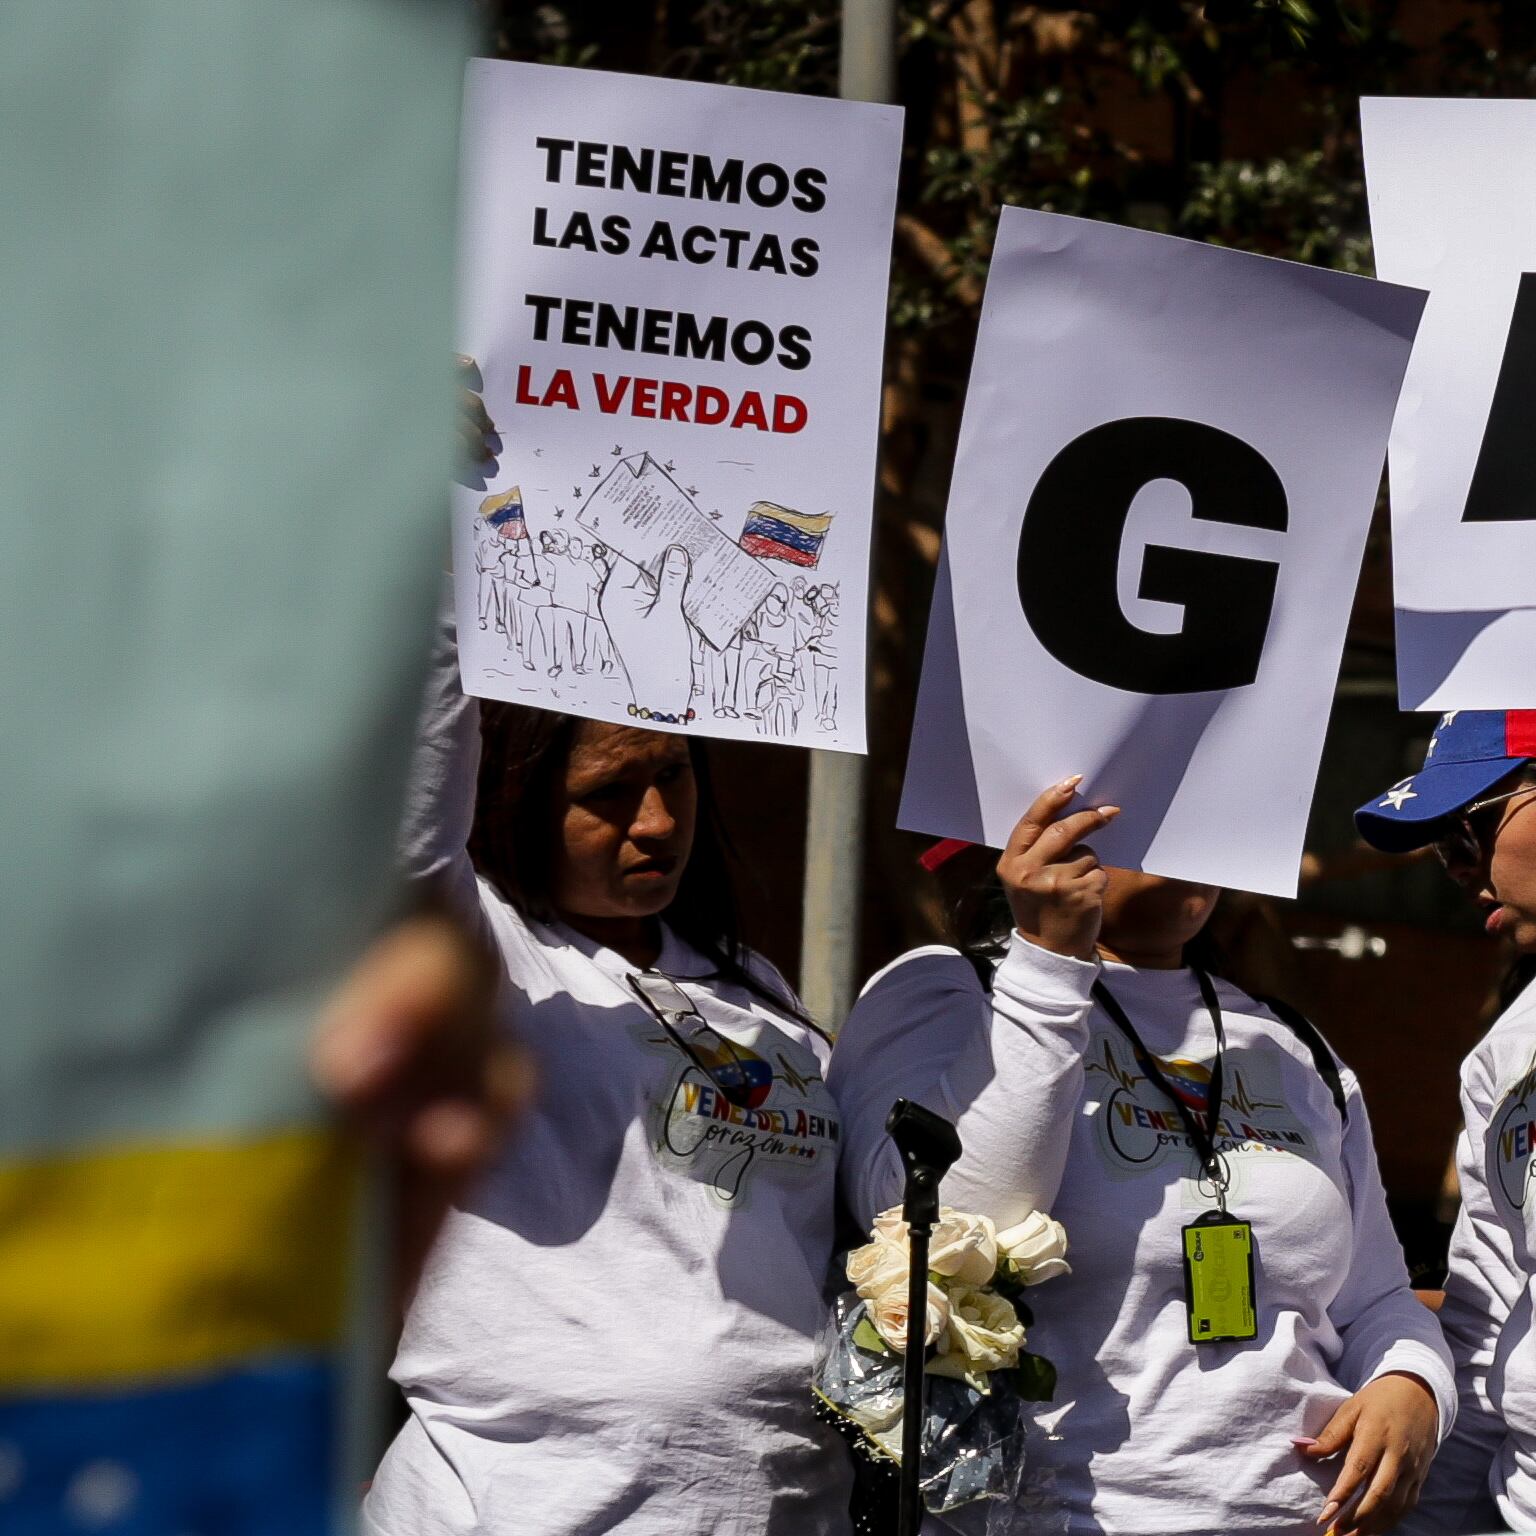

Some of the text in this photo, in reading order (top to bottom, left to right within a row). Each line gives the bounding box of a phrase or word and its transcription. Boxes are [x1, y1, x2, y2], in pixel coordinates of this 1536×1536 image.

[536, 136, 828, 213] TENEMOS
[532, 207, 821, 278] LAS ACTAS
[524, 293, 812, 371] TENEMOS
[515, 365, 808, 434] LA VERDAD
[1016, 416, 1289, 697] G
[808, 1115, 825, 1138] EN
[1263, 1128, 1283, 1142] EN
